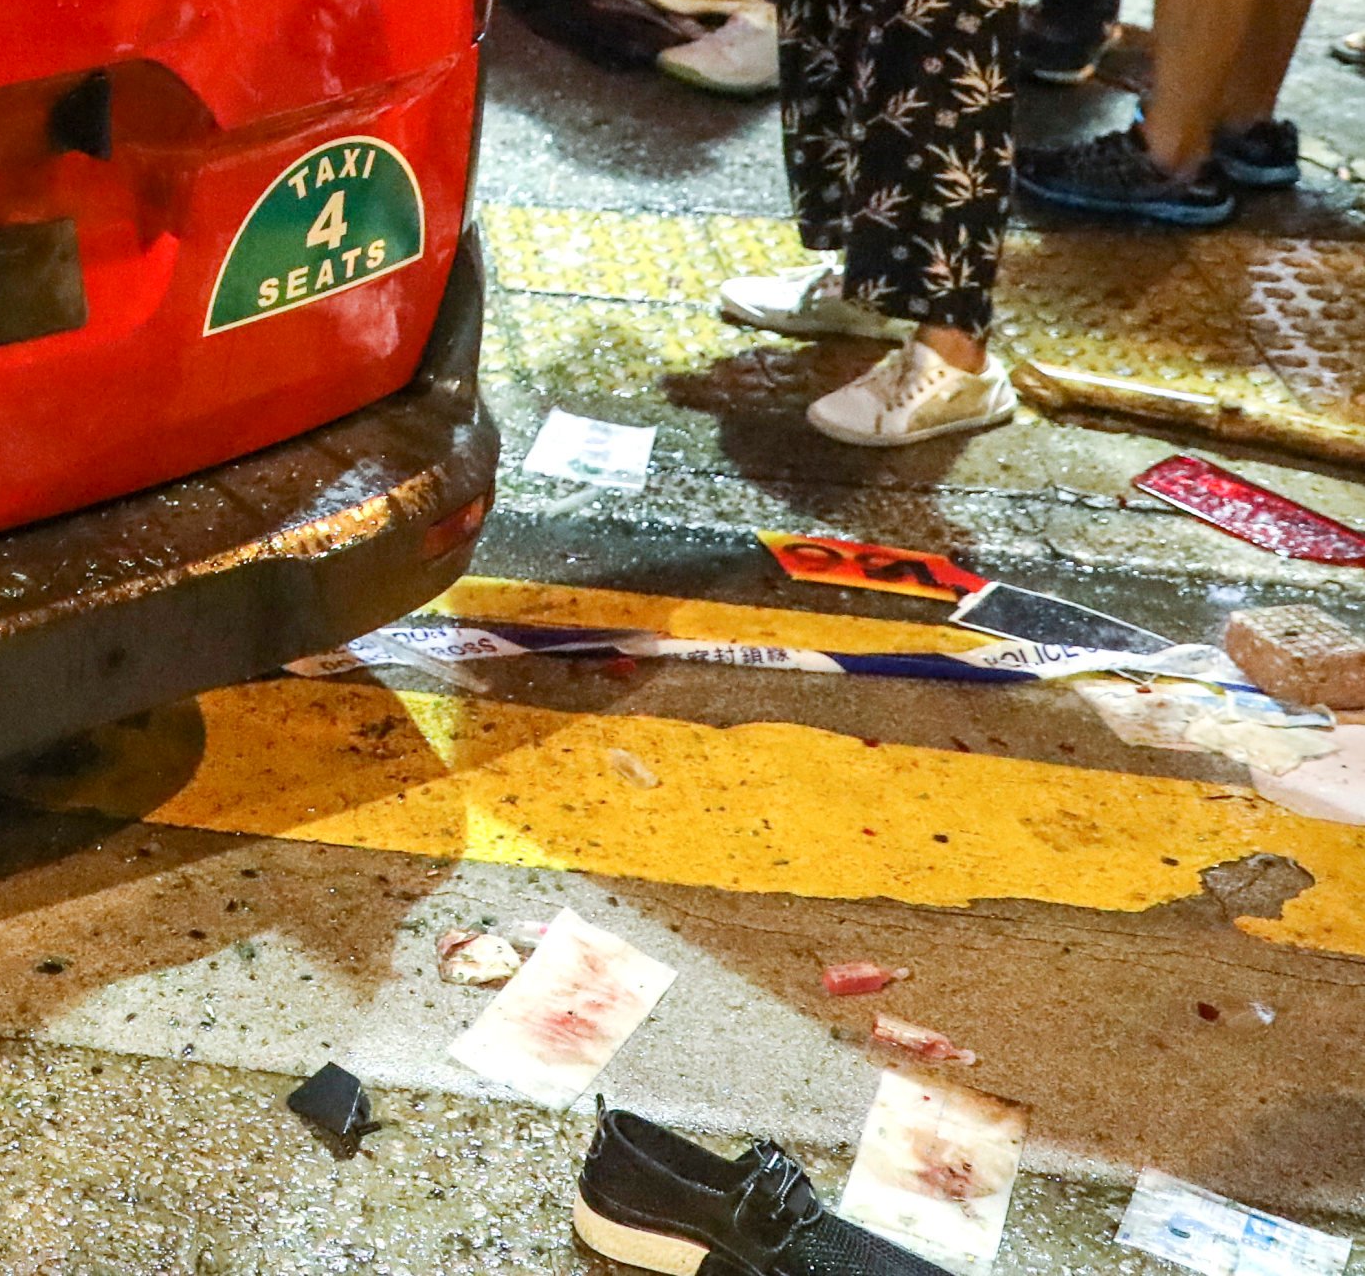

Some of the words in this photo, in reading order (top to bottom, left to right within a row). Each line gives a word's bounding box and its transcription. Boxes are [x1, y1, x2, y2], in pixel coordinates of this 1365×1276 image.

[288, 148, 376, 199] TAXI
[306, 190, 348, 250] 4
[257, 239, 386, 308] SEATS
[430, 637, 501, 658] ROSS
